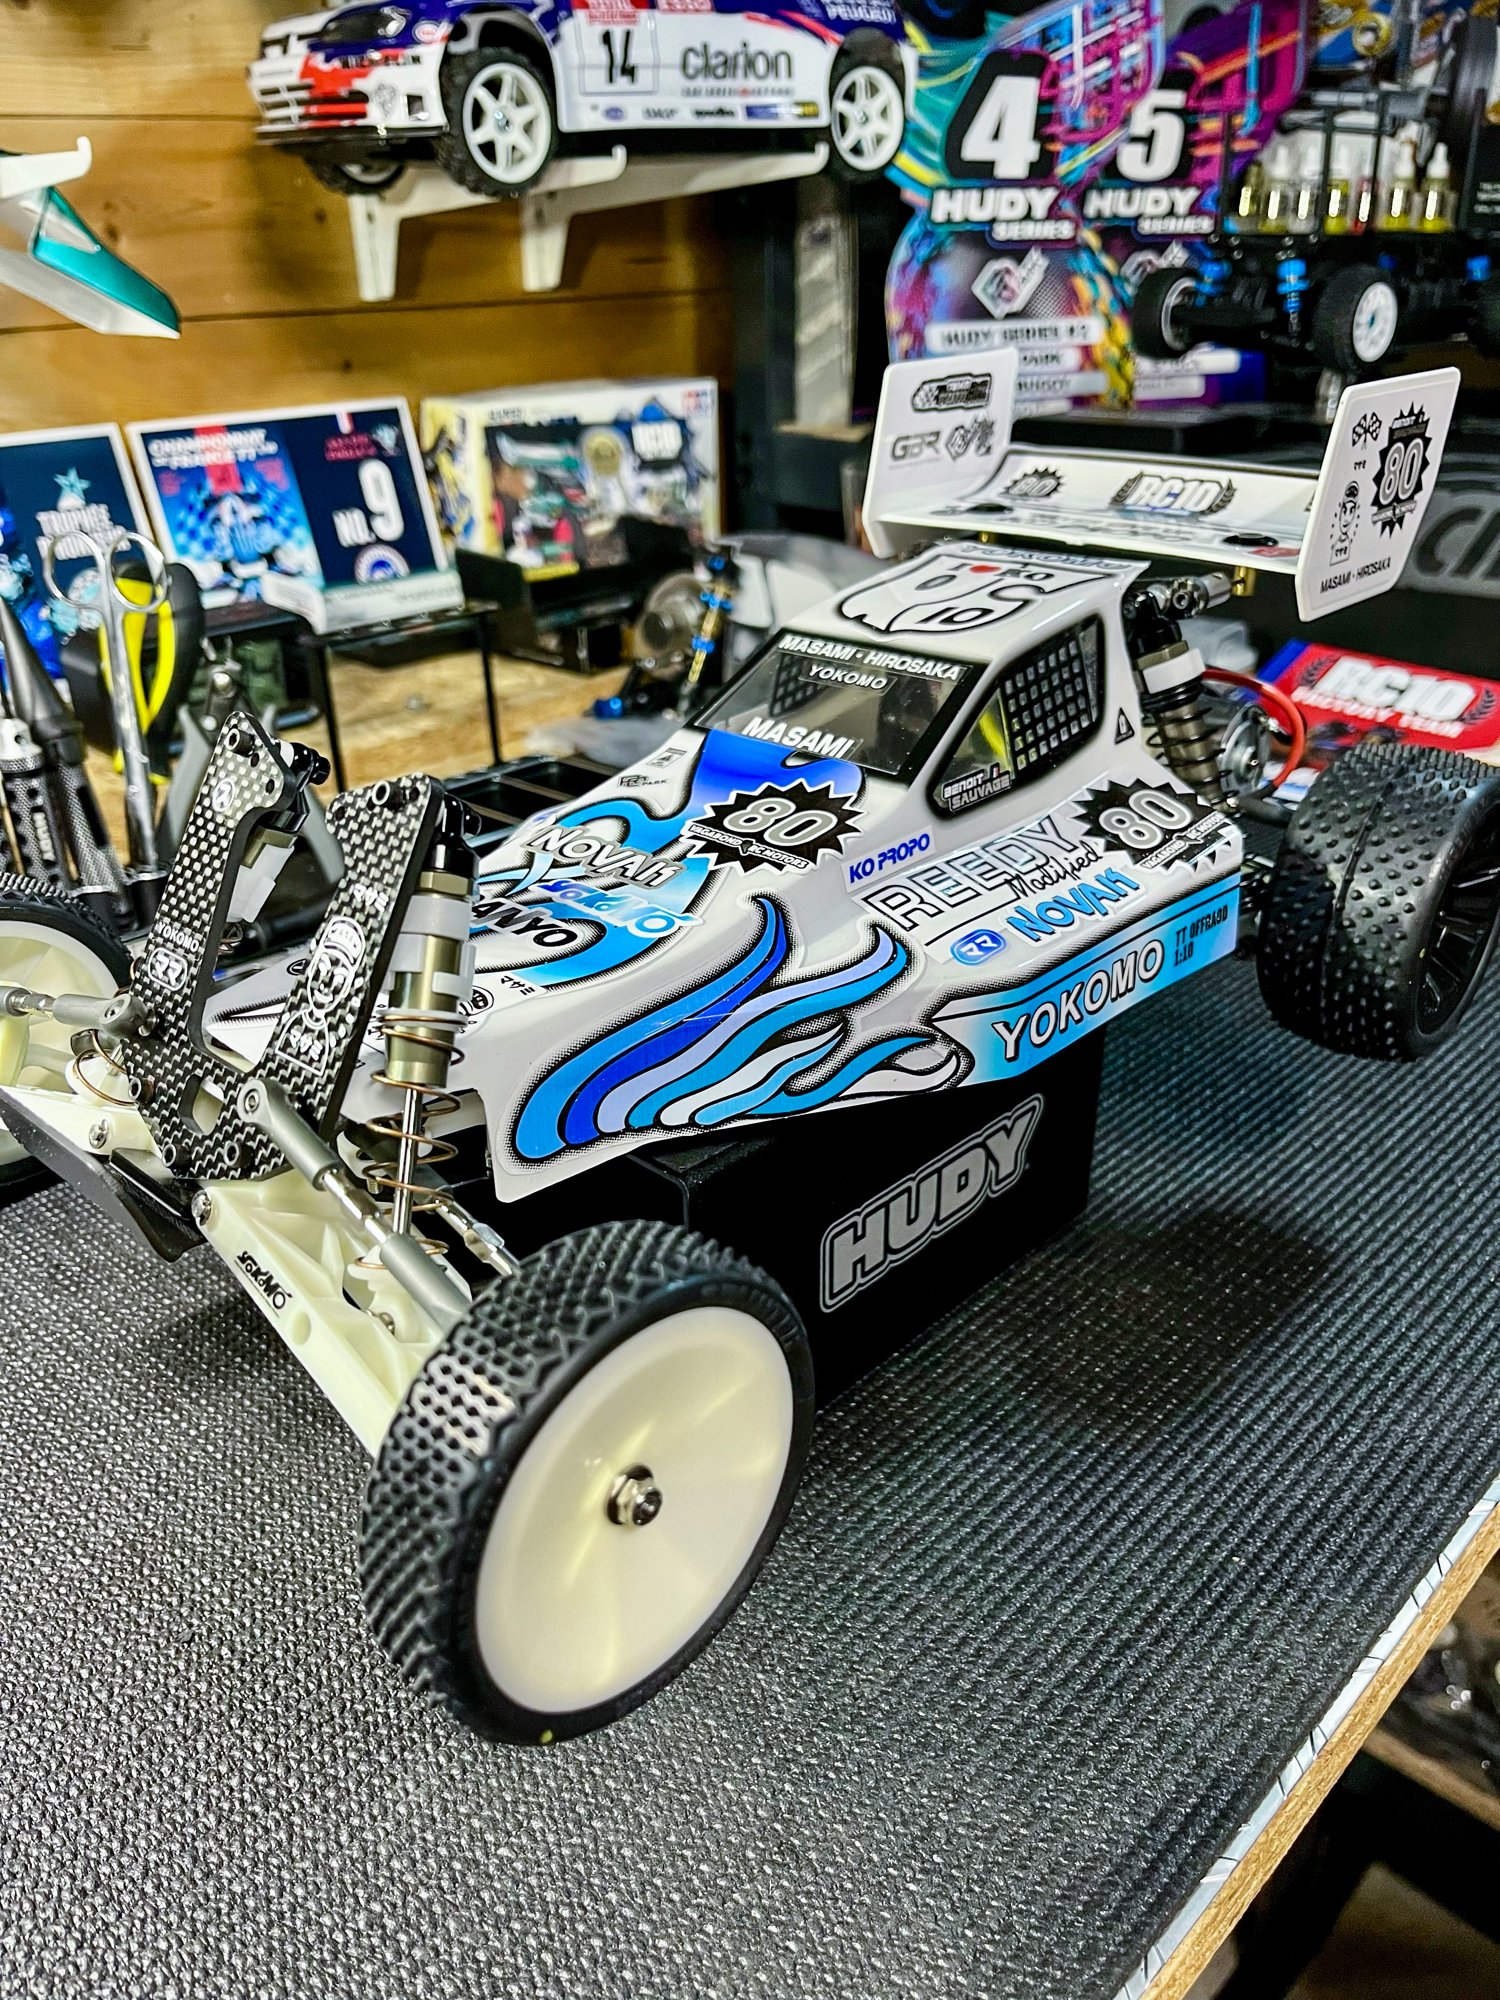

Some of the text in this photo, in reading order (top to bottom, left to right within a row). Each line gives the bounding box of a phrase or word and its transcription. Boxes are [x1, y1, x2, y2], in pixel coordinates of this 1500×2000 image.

[601, 29, 637, 84] 14
[681, 42, 794, 80] clarion
[961, 76, 1041, 179] 4
[1117, 90, 1186, 181] 5
[931, 187, 1060, 222] HUDY
[1083, 187, 1200, 219] HUDY
[1009, 475, 1058, 498] 80
[1124, 475, 1223, 512] RC10
[1379, 438, 1424, 505] 80
[358, 458, 404, 541] 9
[778, 634, 962, 681] MASAMI HIROSAKA
[808, 663, 888, 691] YOKOMO
[1313, 656, 1476, 722] RC10
[741, 716, 856, 760] MASAMI
[944, 772, 984, 799] BENOIT
[951, 774, 1010, 810] SAUVAGE
[723, 797, 838, 847] 80
[1099, 789, 1193, 850] 80
[528, 828, 685, 888] NOVAK
[689, 824, 743, 846] VAGABOND
[762, 846, 809, 869] MOTORS
[849, 833, 931, 884] KO PROPO
[1008, 839, 1104, 898] Modified
[861, 815, 1079, 932] REEDY
[471, 895, 579, 948] ANYO
[1005, 867, 1141, 942] NOVAK
[156, 921, 200, 953] YOKOMO
[1174, 941, 1195, 968] 1:10
[992, 939, 1165, 1062] YOKOMO
[826, 1100, 1040, 1305] HUDY
